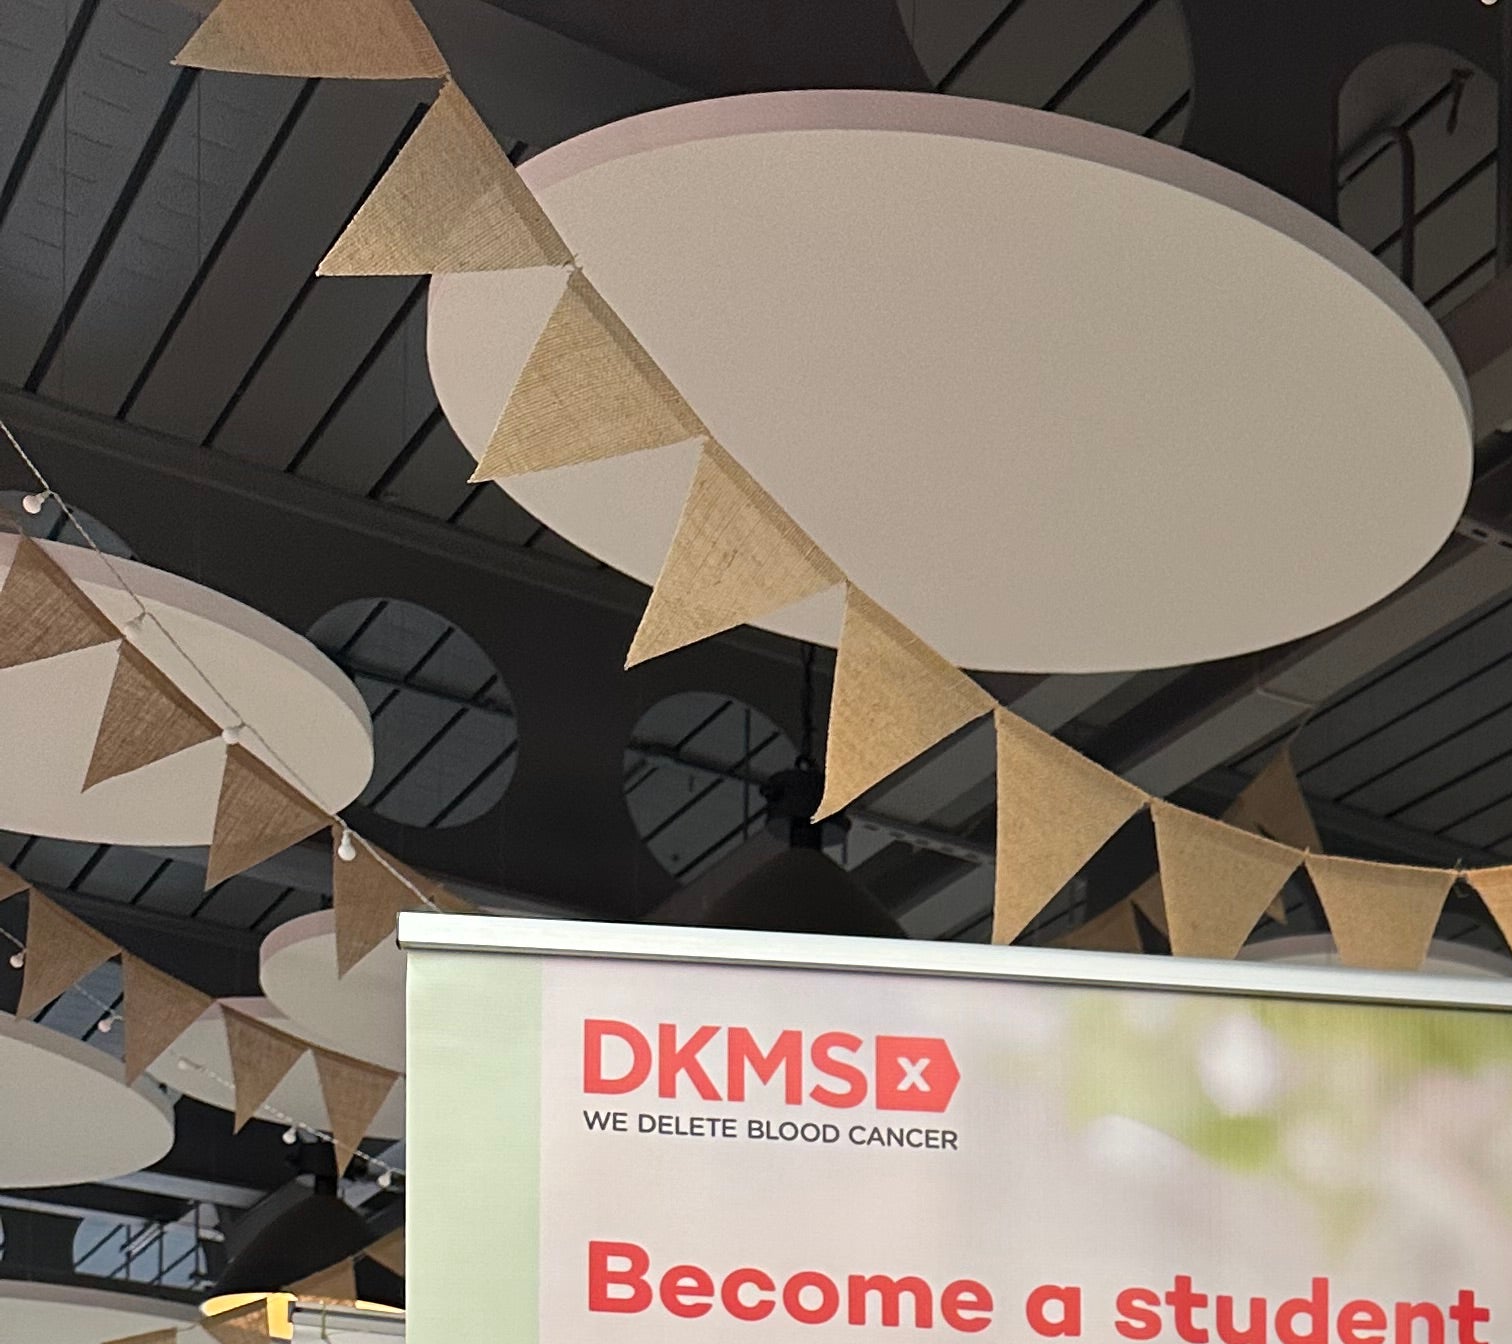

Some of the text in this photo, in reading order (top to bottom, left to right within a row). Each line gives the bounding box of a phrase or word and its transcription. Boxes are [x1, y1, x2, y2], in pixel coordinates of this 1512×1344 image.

[583, 1018, 868, 1110] DKMS
[583, 1110, 958, 1151] WE DELETE BLOOD CANCER
[585, 1240, 996, 1336] Become
[1024, 1281, 1082, 1339] a
